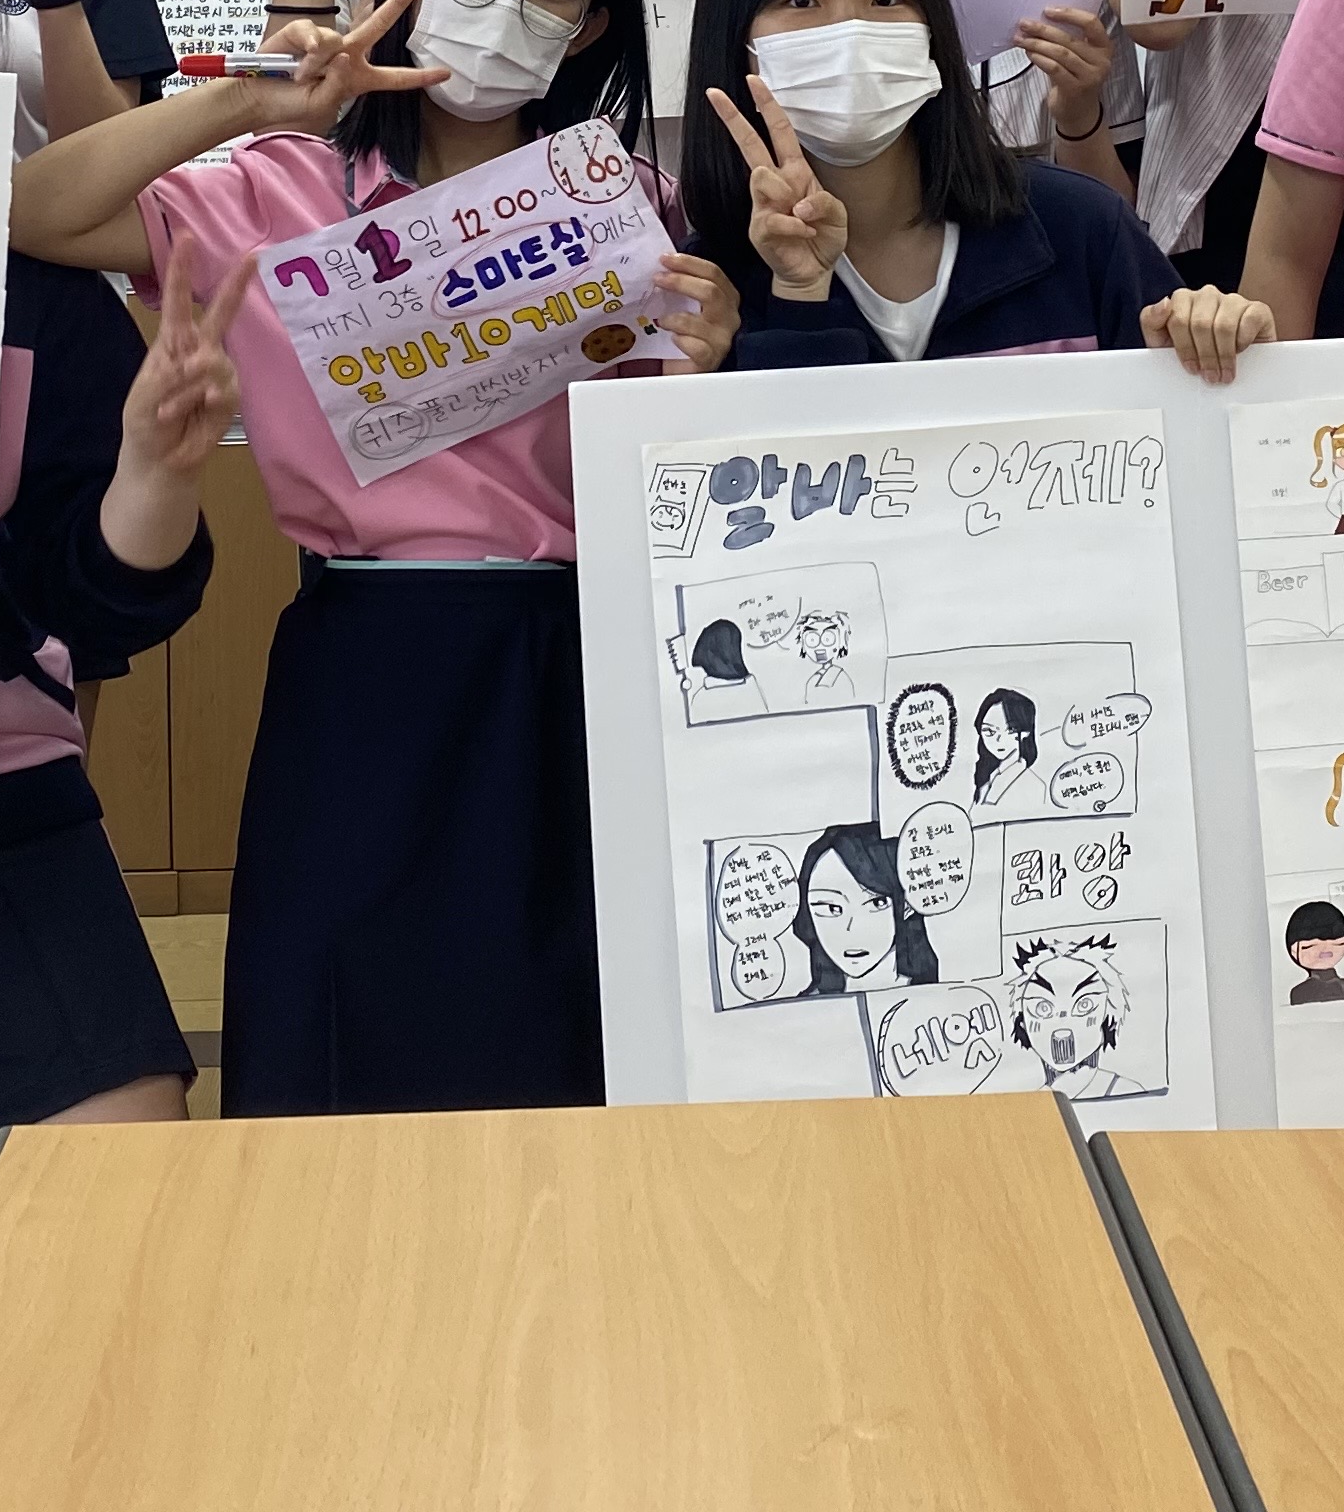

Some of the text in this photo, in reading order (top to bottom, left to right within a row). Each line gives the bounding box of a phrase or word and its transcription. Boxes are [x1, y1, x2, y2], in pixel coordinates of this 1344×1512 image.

[197, 24, 215, 36] 이상
[218, 40, 256, 52] 지급 가능
[708, 435, 1164, 550] 알바는 언제?
[1257, 570, 1308, 593] Beer
